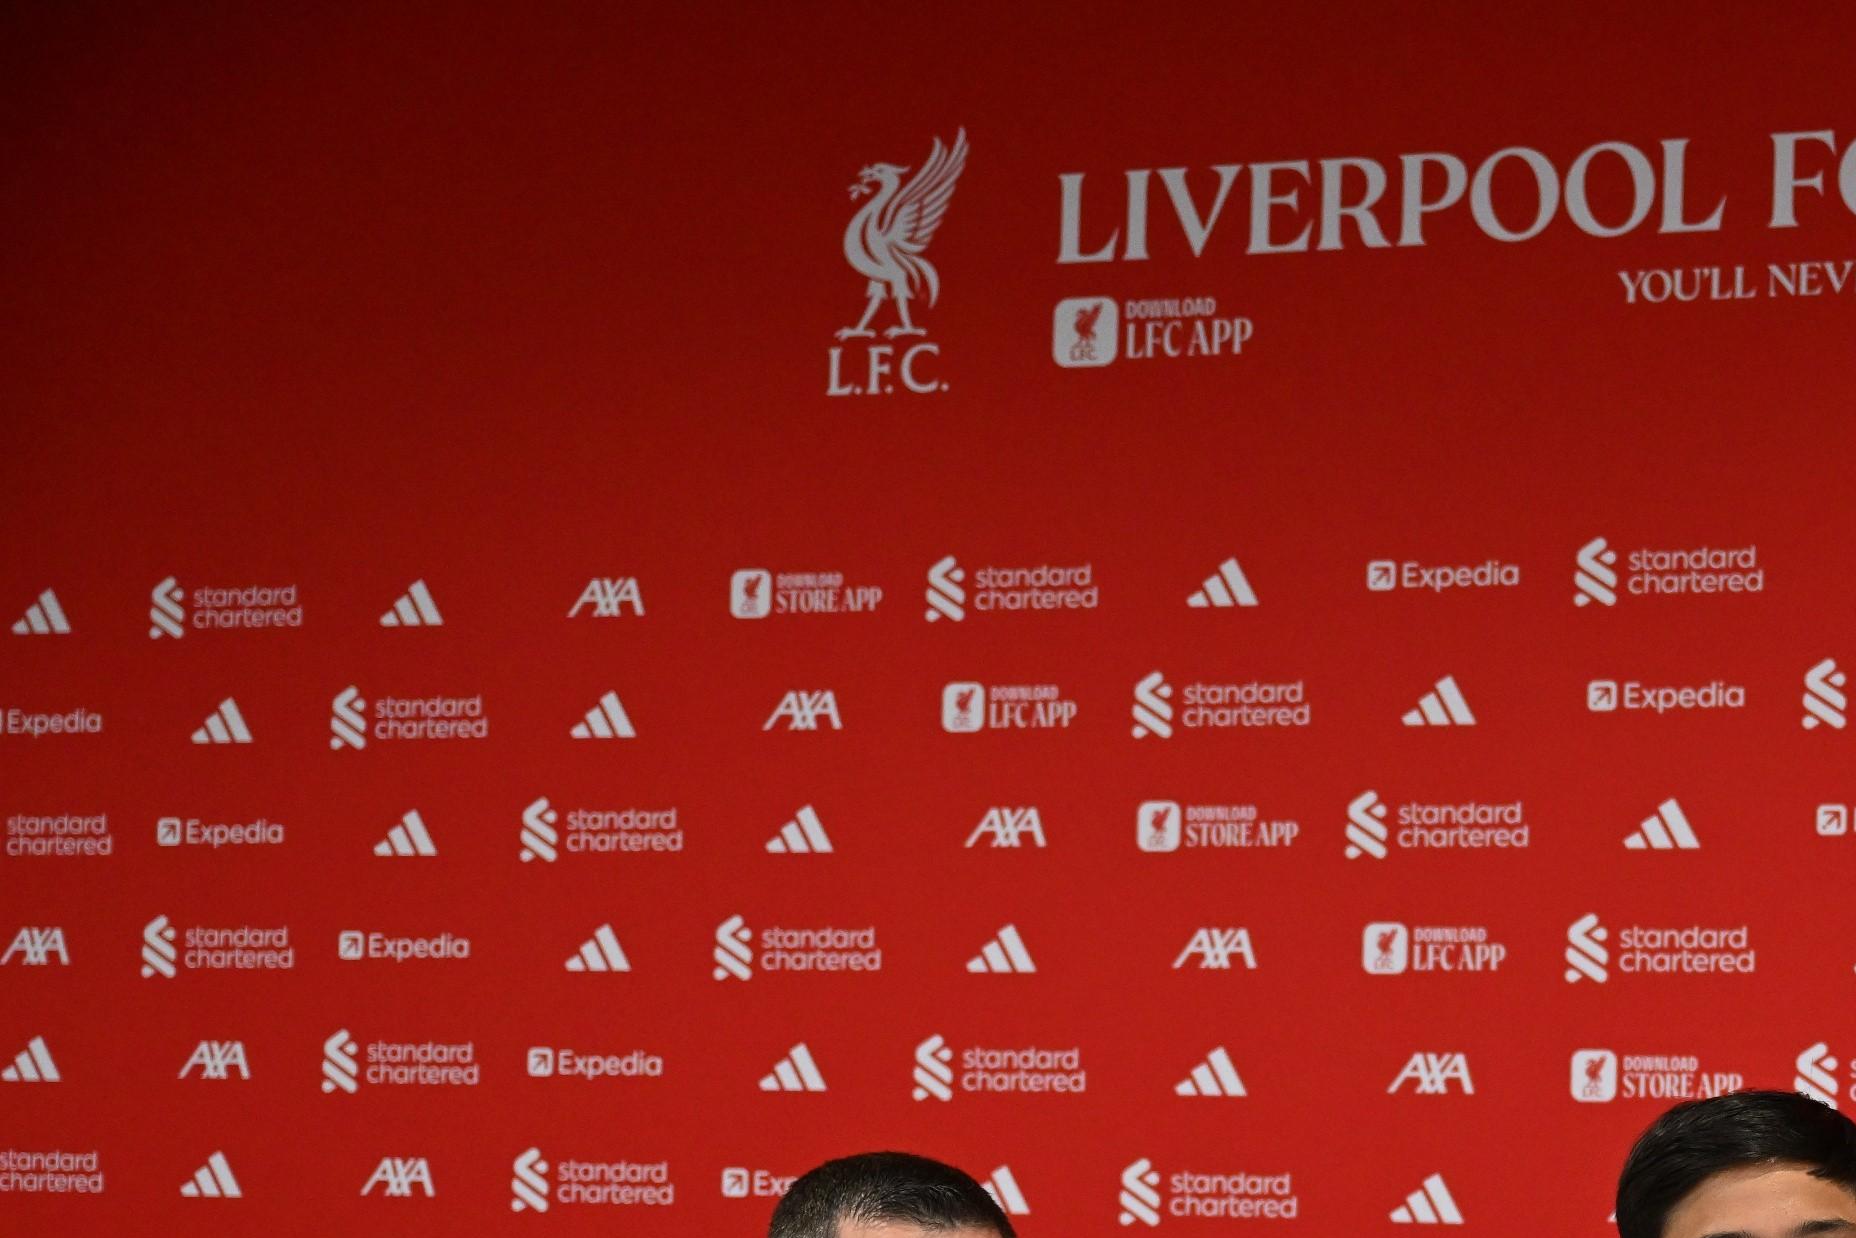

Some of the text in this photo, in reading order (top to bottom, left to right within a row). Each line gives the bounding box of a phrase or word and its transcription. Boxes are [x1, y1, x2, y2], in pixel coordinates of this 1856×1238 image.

[1057, 138, 1726, 264] LIVERPOOL
[1618, 266, 1757, 304] YOU'LL
[1126, 318, 1253, 358] LFC APP
[826, 342, 950, 397] L.F.C.
[1629, 546, 1756, 571] standard
[976, 565, 1091, 589] standard
[1402, 560, 1519, 592] Expedia
[1628, 569, 1764, 594] chartered
[194, 586, 296, 609] standard
[568, 577, 645, 617] AXA
[776, 586, 882, 613] STORE APP
[975, 587, 1098, 610] chartered
[193, 607, 302, 628] chartered
[1183, 681, 1303, 706] standard
[1623, 681, 1745, 714] Expedia
[376, 696, 481, 719] standard
[763, 690, 842, 731] AXA
[989, 700, 1077, 728] LFC APP
[1182, 704, 1310, 727] chartered
[7, 709, 103, 737] Expedia
[375, 718, 488, 739] chartered
[8, 814, 106, 837] standard
[567, 808, 676, 832] standard
[1399, 802, 1522, 826] standard
[186, 819, 284, 848] Expedia
[964, 806, 1047, 848] AXA
[1185, 820, 1299, 847] STORE APP
[1397, 826, 1529, 848] chartered
[7, 835, 112, 855] chartered
[566, 830, 683, 852] chartered
[0, 927, 70, 965] AXA
[186, 927, 288, 948] standard
[368, 932, 470, 962] Expedia
[762, 927, 875, 950] standard
[1172, 928, 1257, 969] AXA
[1620, 926, 1748, 950] standard
[185, 948, 294, 968] chartered
[761, 949, 881, 971] chartered
[1412, 942, 1507, 971] LFC APP
[1619, 950, 1755, 973] chartered
[178, 1040, 250, 1080] AXA
[367, 1041, 473, 1063] standard
[963, 1047, 1079, 1070] standard
[1623, 1056, 1698, 1072] DOWNLOAD
[366, 1063, 479, 1085] chartered
[558, 1049, 663, 1080] Expedia
[1387, 1052, 1475, 1095] AXA
[962, 1070, 1086, 1092] chartered
[1621, 1073, 1695, 1098] STORE
[0, 1150, 98, 1172] standard
[558, 1160, 667, 1183] standard
[0, 1172, 104, 1193] chartered
[361, 1157, 435, 1197] AXA
[1171, 1171, 1297, 1198] standard
[557, 1183, 674, 1205] chartered
[1169, 1195, 1298, 1219] chartered
